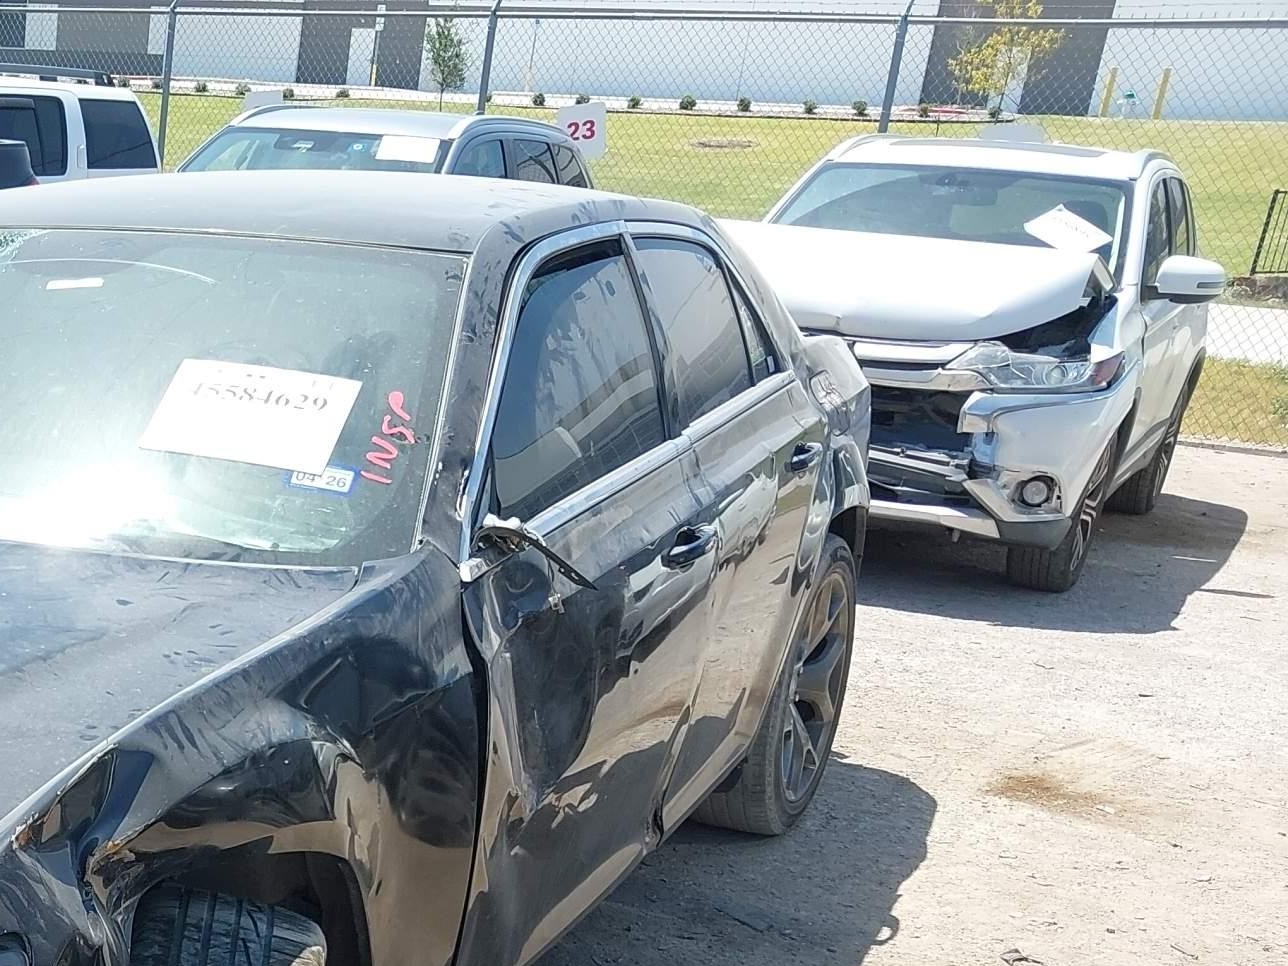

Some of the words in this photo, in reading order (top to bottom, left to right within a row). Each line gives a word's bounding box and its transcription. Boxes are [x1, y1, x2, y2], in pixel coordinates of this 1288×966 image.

[567, 119, 596, 141] 23
[360, 391, 415, 484] INSP
[325, 475, 347, 488] 26
